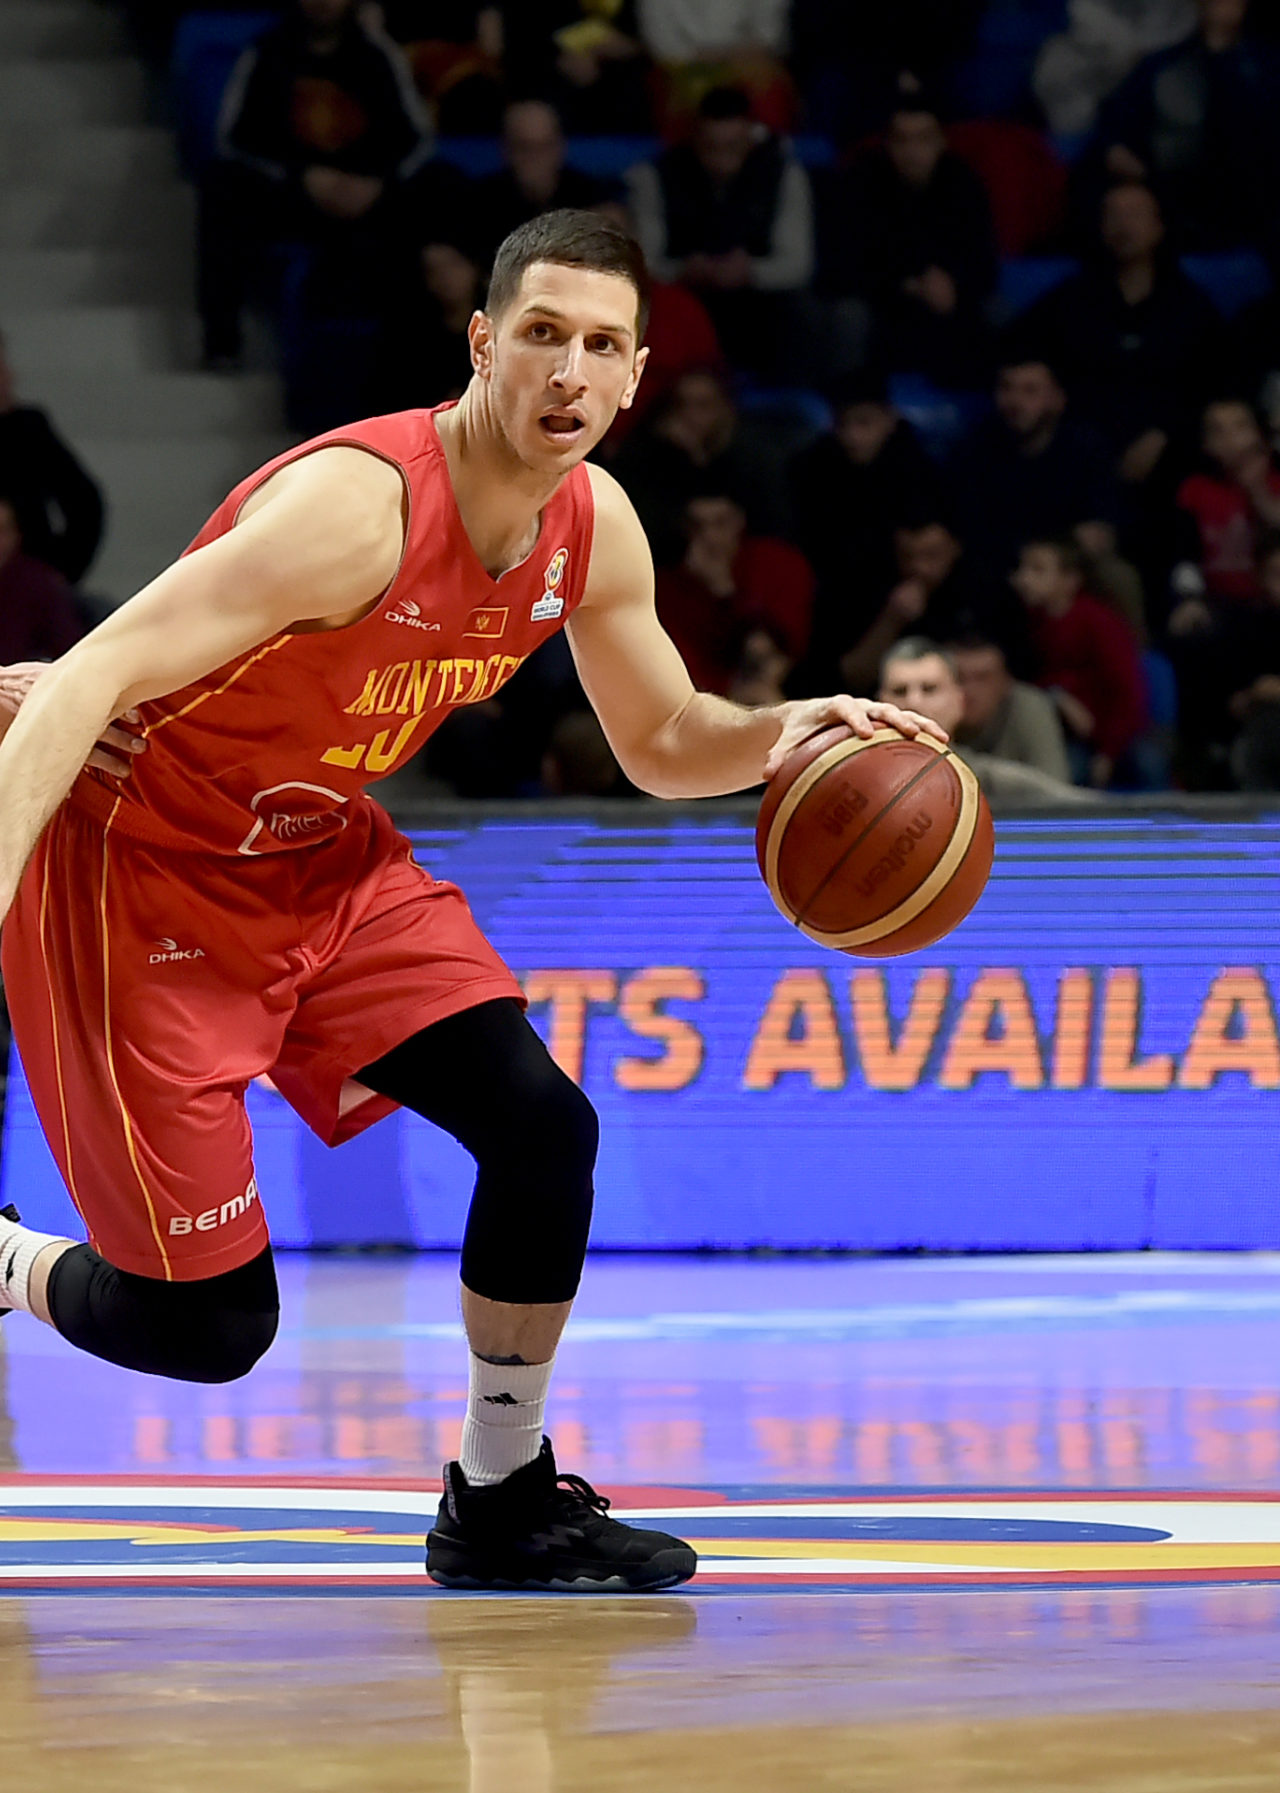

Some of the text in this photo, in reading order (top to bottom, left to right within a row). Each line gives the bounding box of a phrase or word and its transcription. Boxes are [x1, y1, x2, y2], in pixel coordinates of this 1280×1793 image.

[384, 610, 442, 633] DHIKA
[148, 948, 206, 965] DHIKA
[168, 1177, 258, 1236] BEMA
